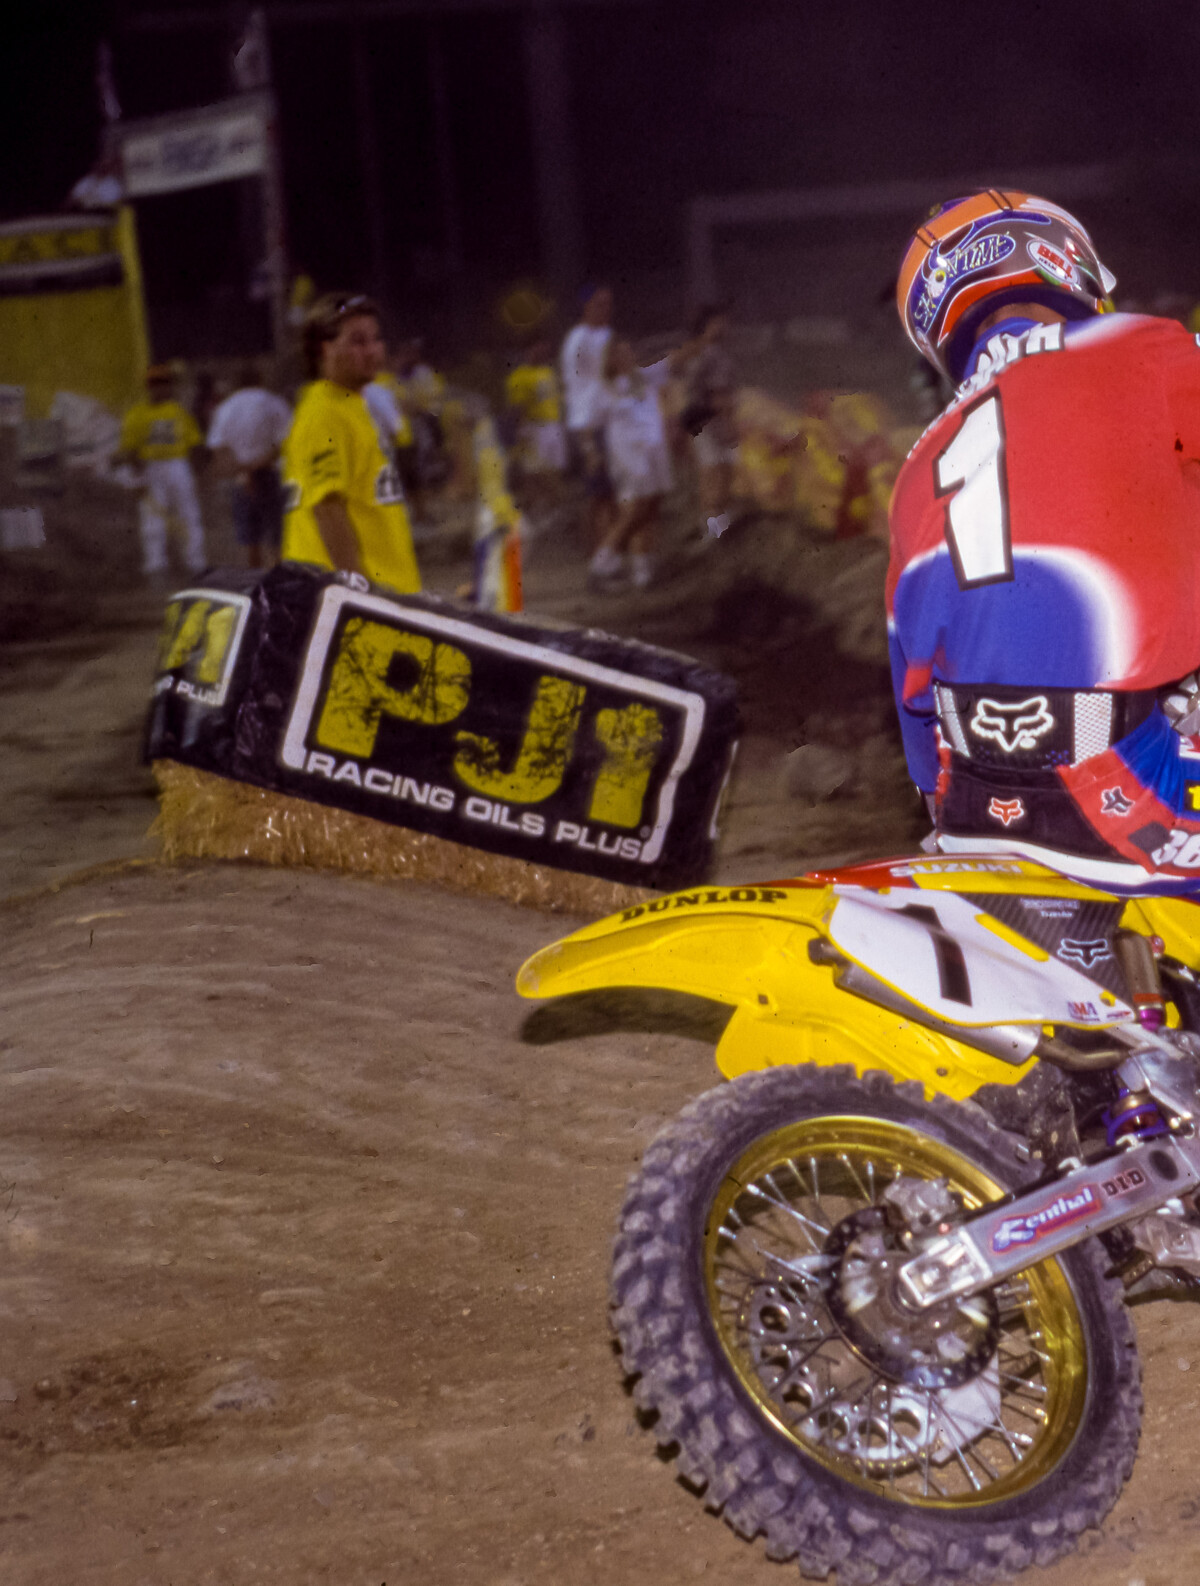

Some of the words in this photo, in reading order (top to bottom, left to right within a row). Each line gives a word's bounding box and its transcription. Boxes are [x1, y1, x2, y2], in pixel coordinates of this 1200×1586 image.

[1037, 243, 1073, 280] BELL
[934, 388, 1013, 588] 1
[316, 616, 663, 829] PJ1
[306, 751, 455, 812] RACING
[465, 796, 545, 837] OILS
[555, 820, 643, 861] PLUS
[889, 862, 1023, 878] SUZUKI
[619, 887, 788, 924] DUNLOP
[898, 902, 973, 1007] 1
[1102, 1169, 1144, 1197] DID
[993, 1187, 1094, 1252] Renthal
